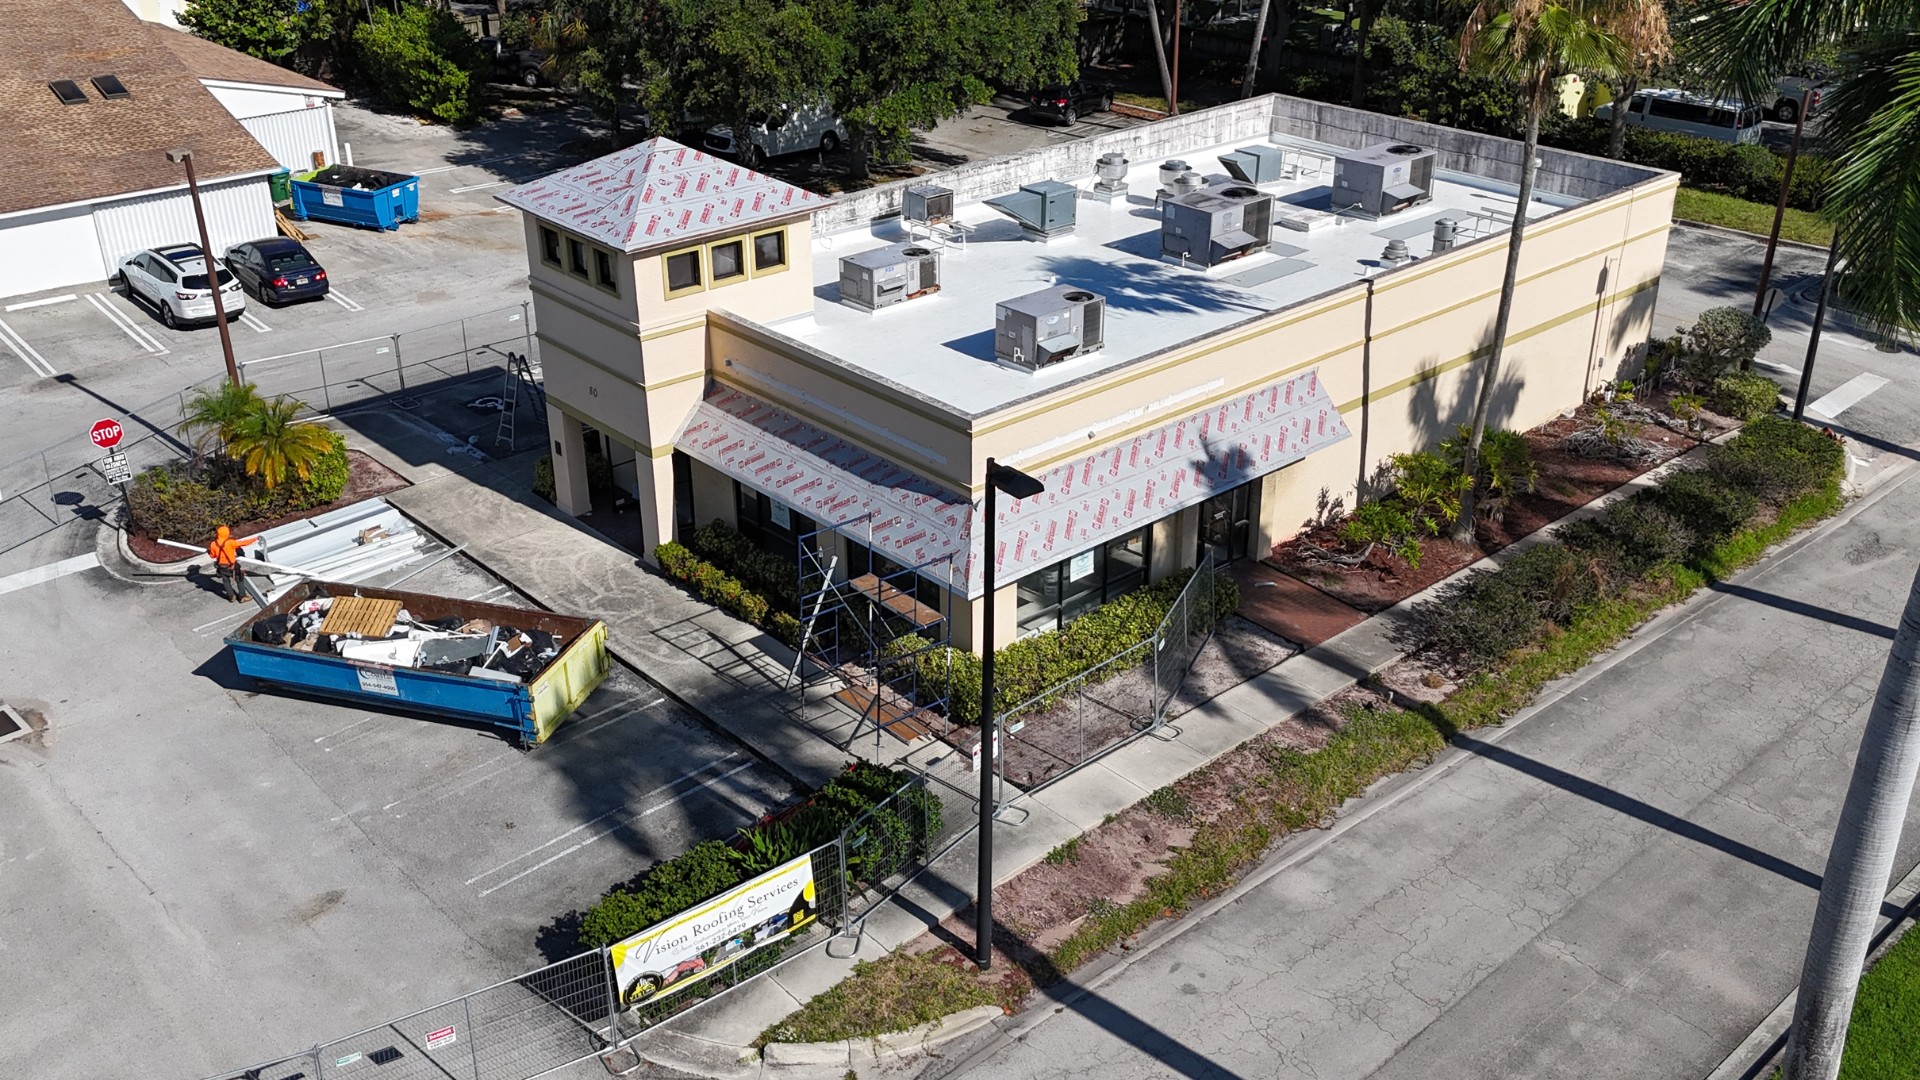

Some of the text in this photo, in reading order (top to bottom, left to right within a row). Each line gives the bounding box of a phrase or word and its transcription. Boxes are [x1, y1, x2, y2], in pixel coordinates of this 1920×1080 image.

[92, 425, 120, 442] STOP
[635, 929, 688, 963] Vision
[692, 905, 745, 937] Roofing
[747, 878, 799, 908] Services
[695, 921, 747, 952] 561-232-6479
